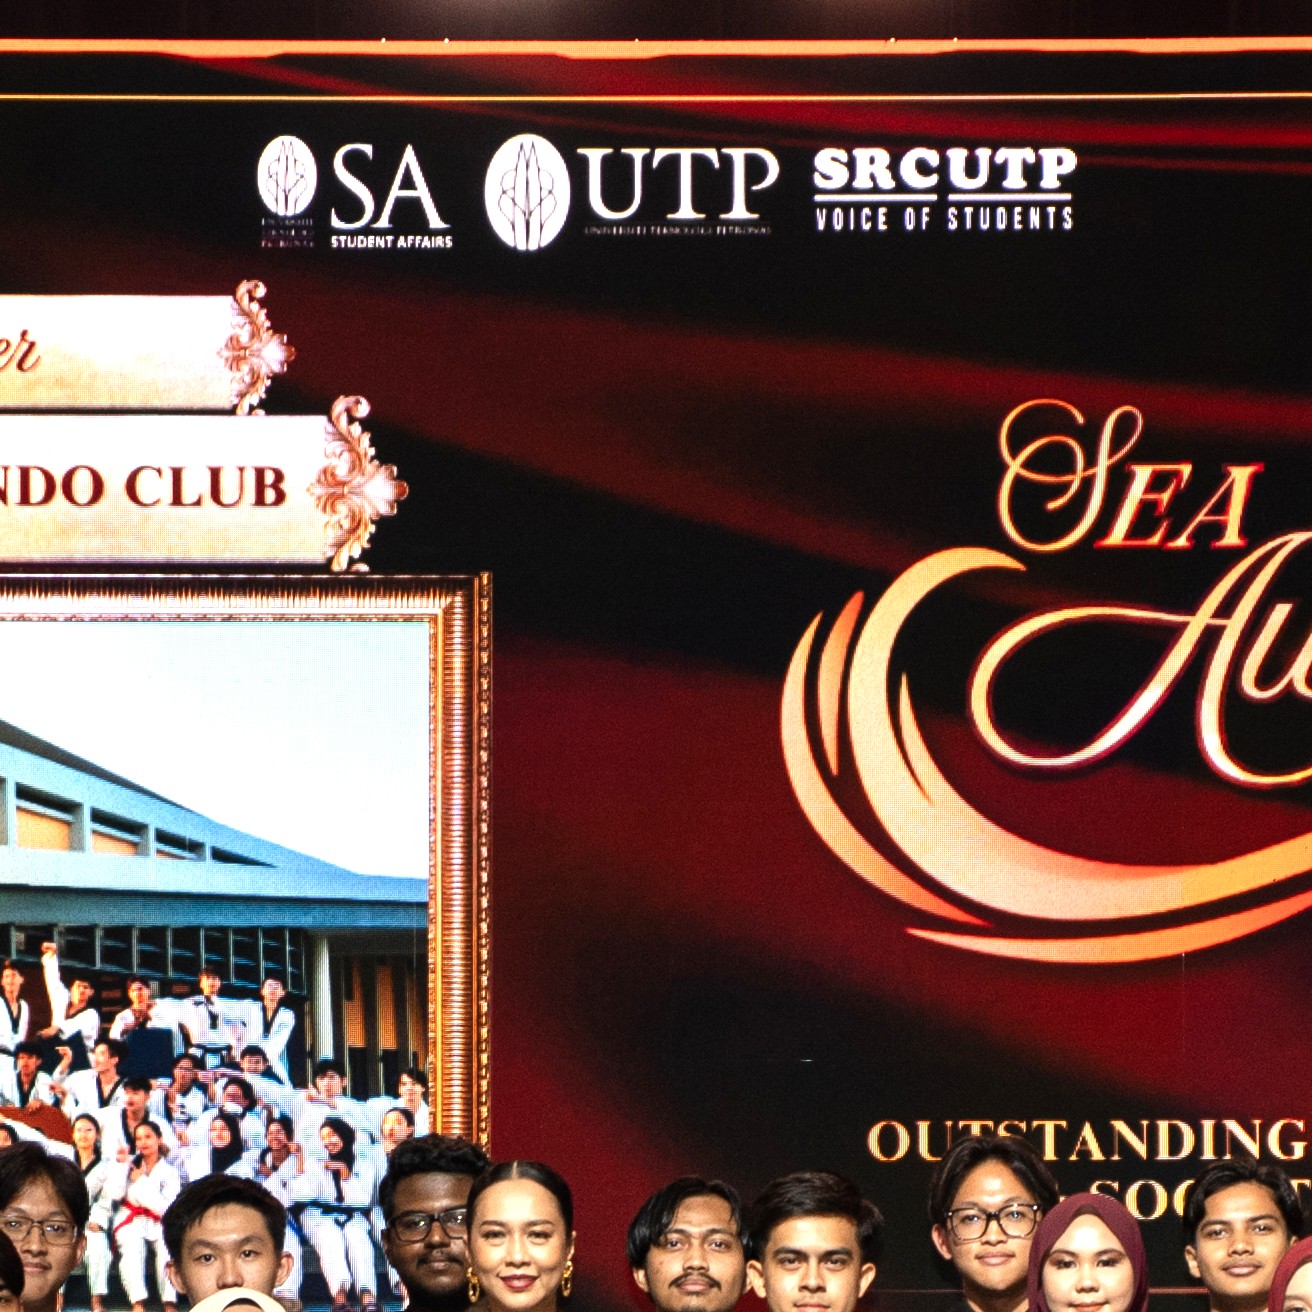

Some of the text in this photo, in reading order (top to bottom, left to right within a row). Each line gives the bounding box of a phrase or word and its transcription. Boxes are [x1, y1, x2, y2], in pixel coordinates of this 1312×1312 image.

[331, 143, 451, 230] SA
[576, 147, 780, 220] UTP
[813, 147, 1077, 190] SRCUTP
[816, 206, 1074, 231] VOICE OF STUDENTS
[331, 235, 454, 249] STUDENT AFFAIRS
[124, 465, 288, 508] CLUB
